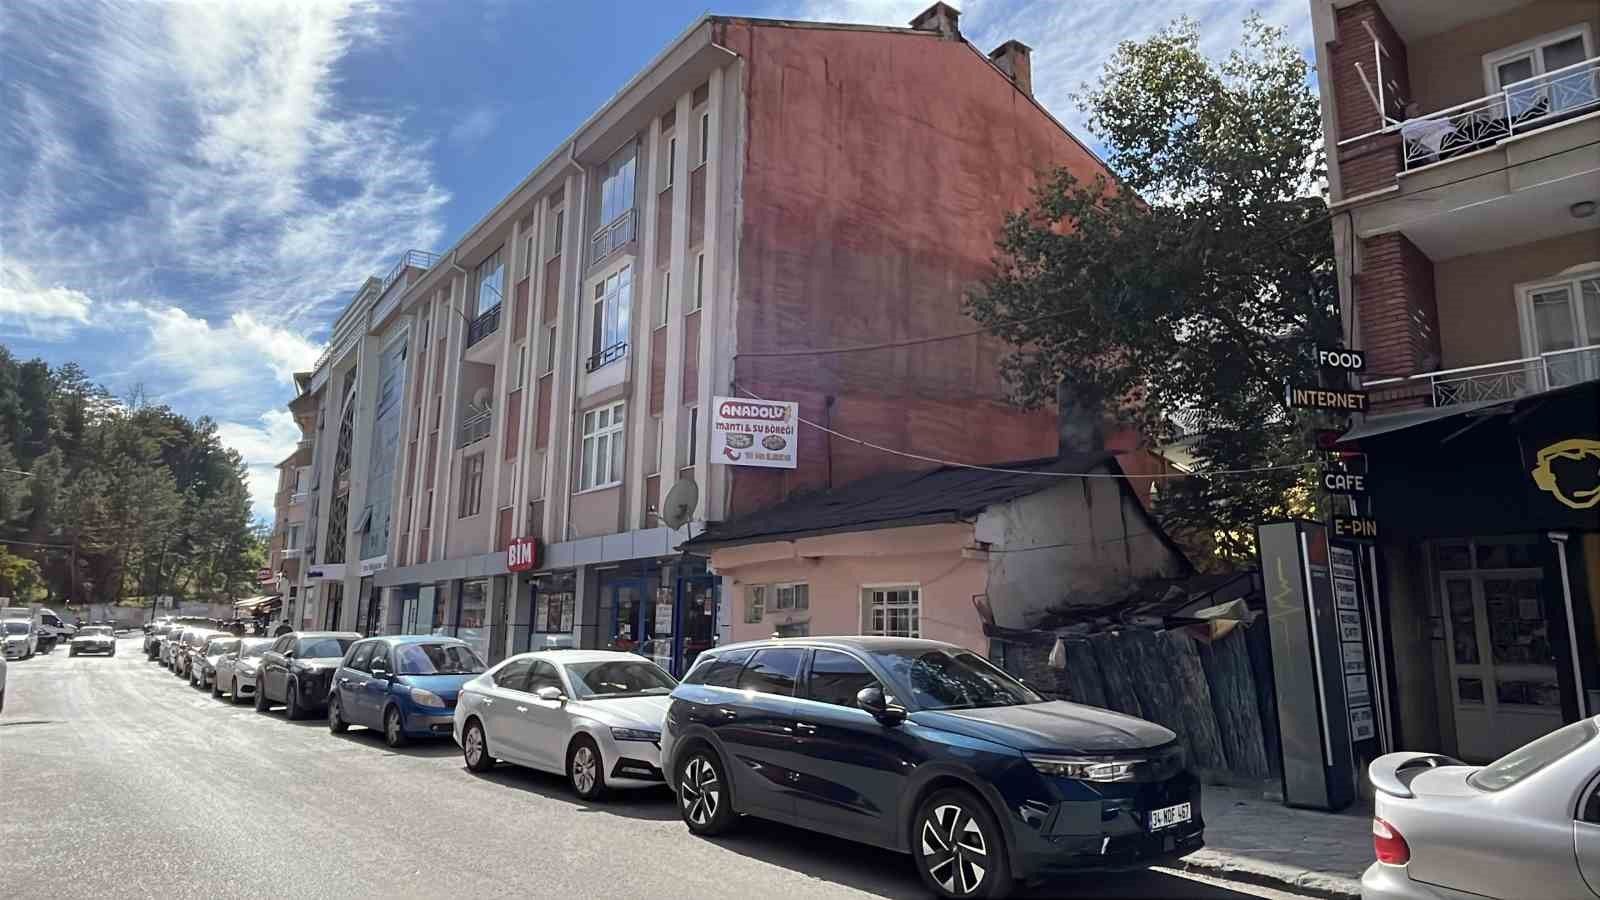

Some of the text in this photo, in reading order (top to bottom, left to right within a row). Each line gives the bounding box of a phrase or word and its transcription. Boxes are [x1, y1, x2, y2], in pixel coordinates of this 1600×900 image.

[1319, 351, 1362, 368] FOOD
[1293, 389, 1366, 409] INTERNET
[721, 404, 783, 418] ANADOLU
[1325, 474, 1365, 491] CAFE
[508, 538, 532, 566] BİM
